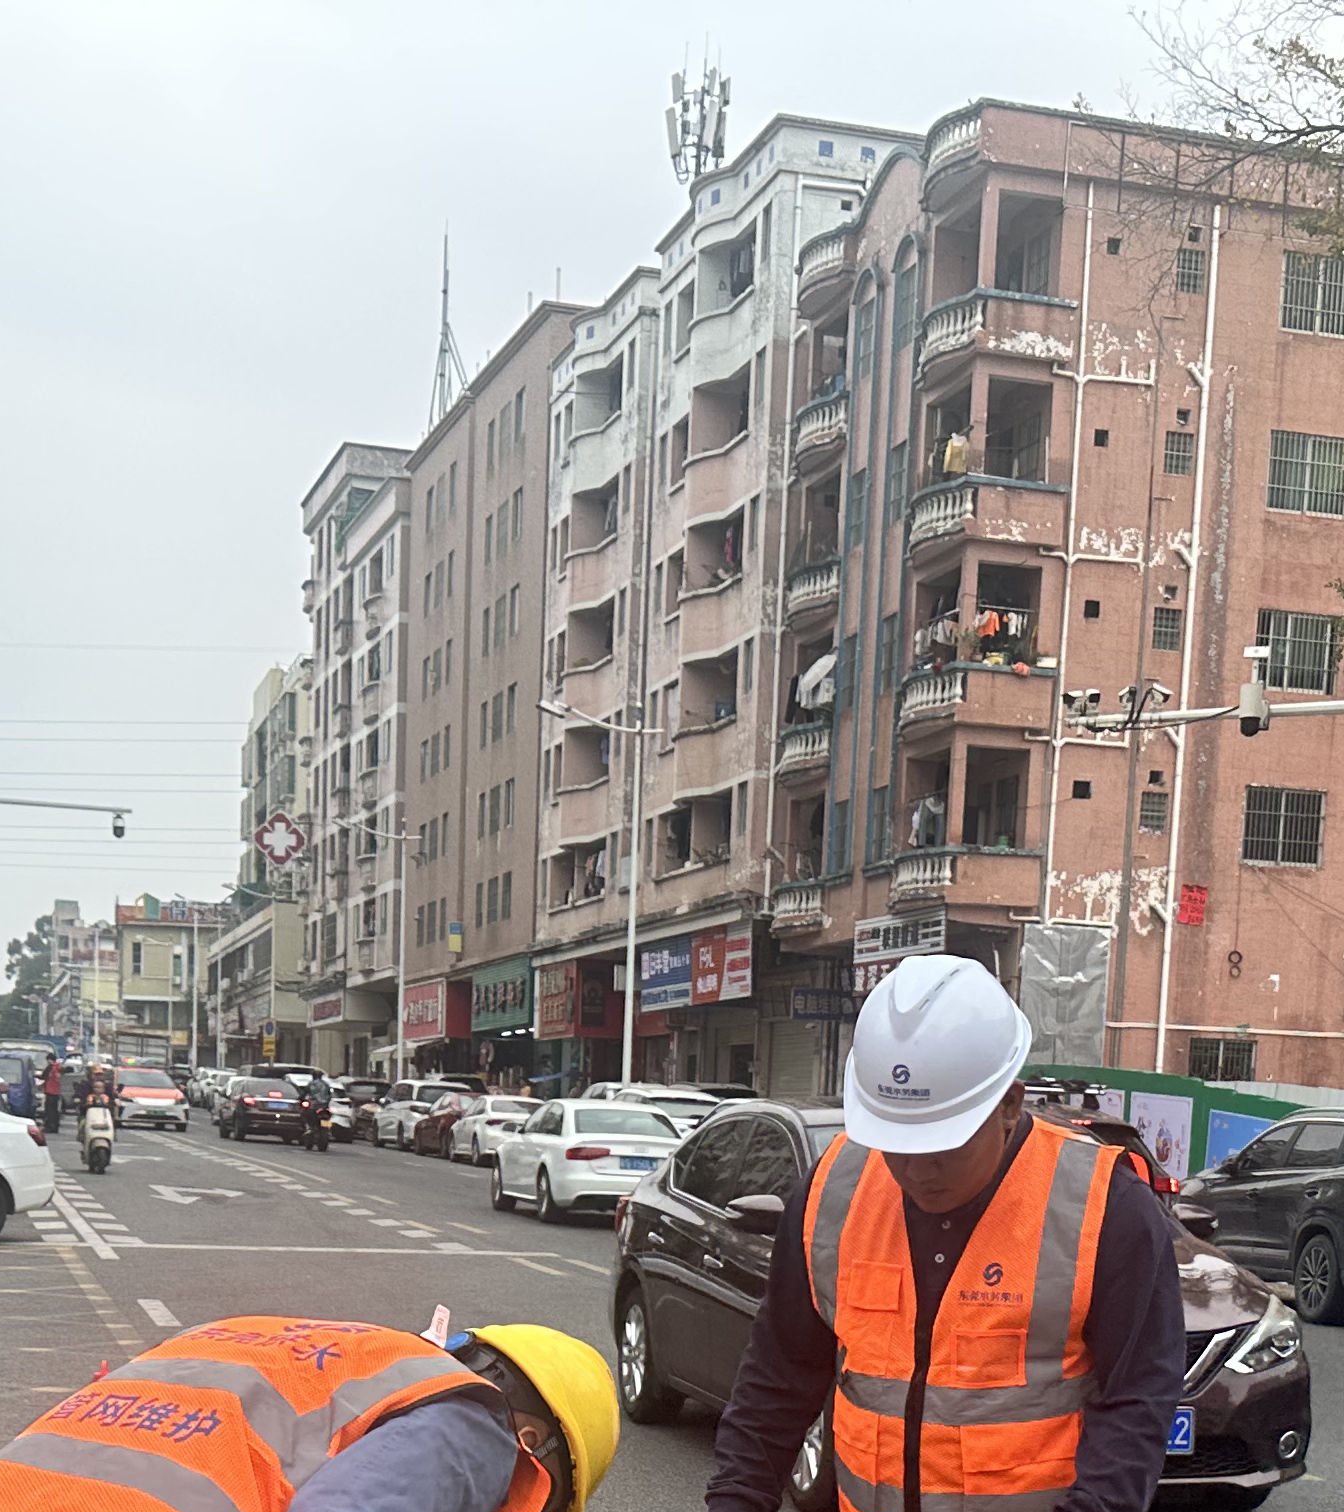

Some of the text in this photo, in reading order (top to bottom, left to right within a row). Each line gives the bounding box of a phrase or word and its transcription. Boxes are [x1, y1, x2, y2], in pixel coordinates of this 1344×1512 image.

[877, 1084, 931, 1097] 东莞水务集团
[958, 1290, 1023, 1303] 东莞水务集团
[47, 1391, 222, 1443] 管网维护
